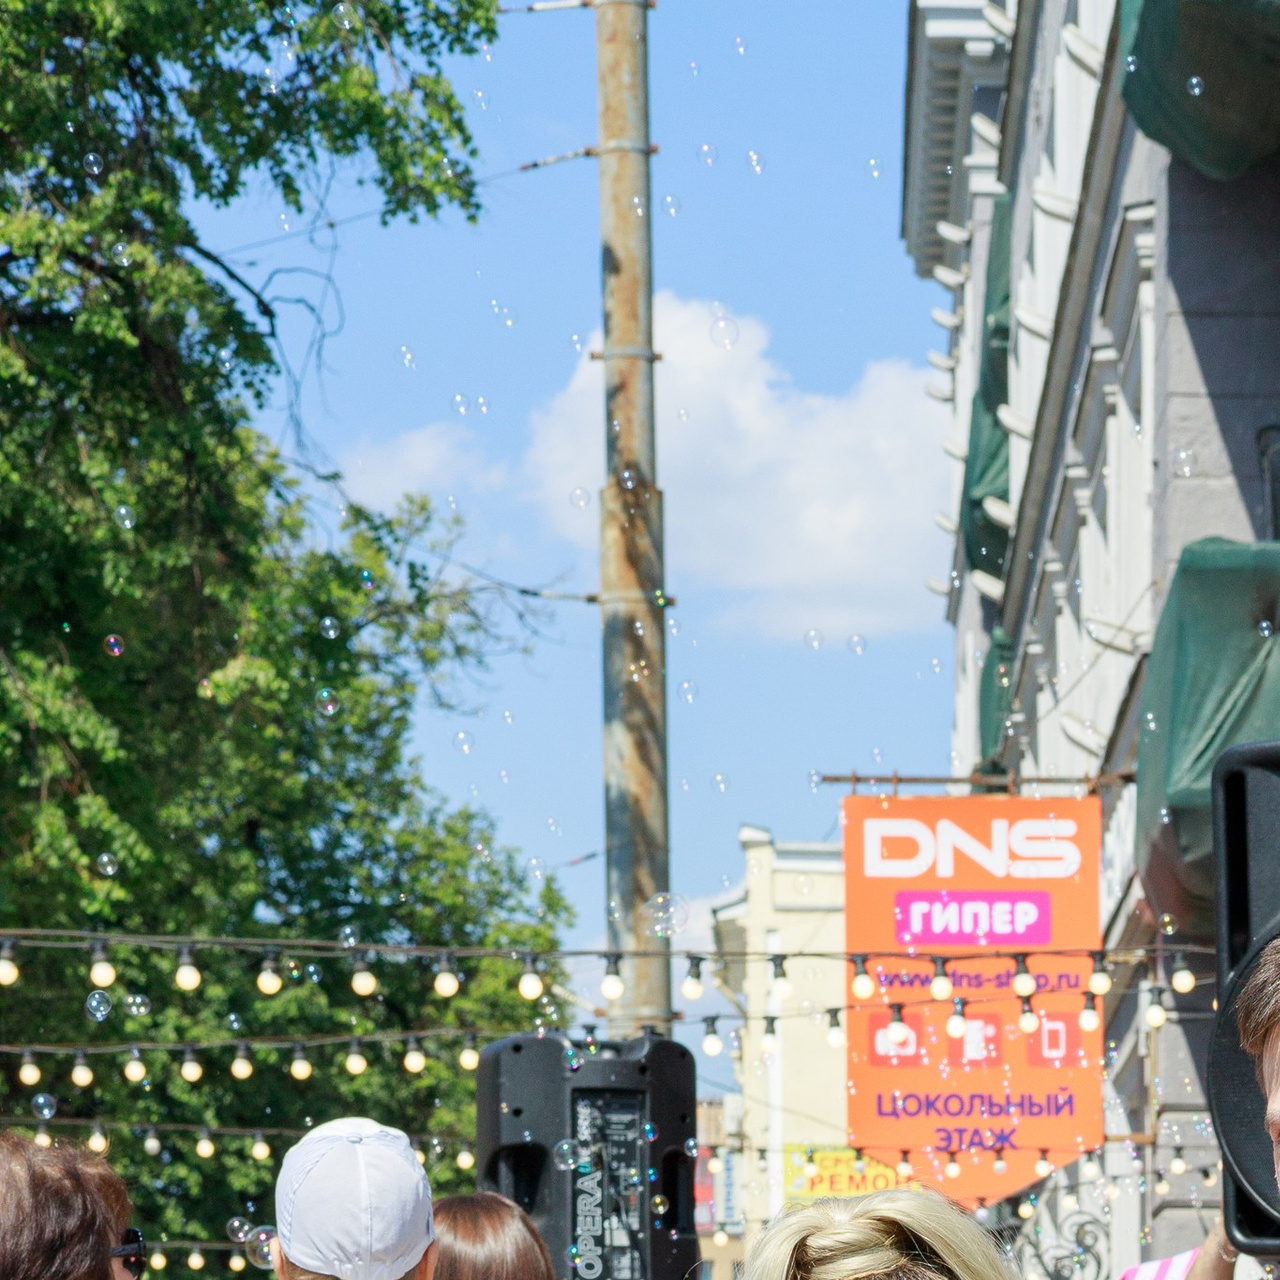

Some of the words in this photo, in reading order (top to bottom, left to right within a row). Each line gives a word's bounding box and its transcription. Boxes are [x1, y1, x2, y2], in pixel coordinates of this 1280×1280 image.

[863, 818, 1082, 878] DNS
[909, 901, 1039, 934] ГИПЕР
[877, 969, 1079, 992] wwwdns-shp.ru
[876, 1087, 1075, 1119] ЦОКОЛЬНЫЙ
[935, 1127, 1017, 1151] ЭТАЖ
[577, 1171, 603, 1279] OPERA
